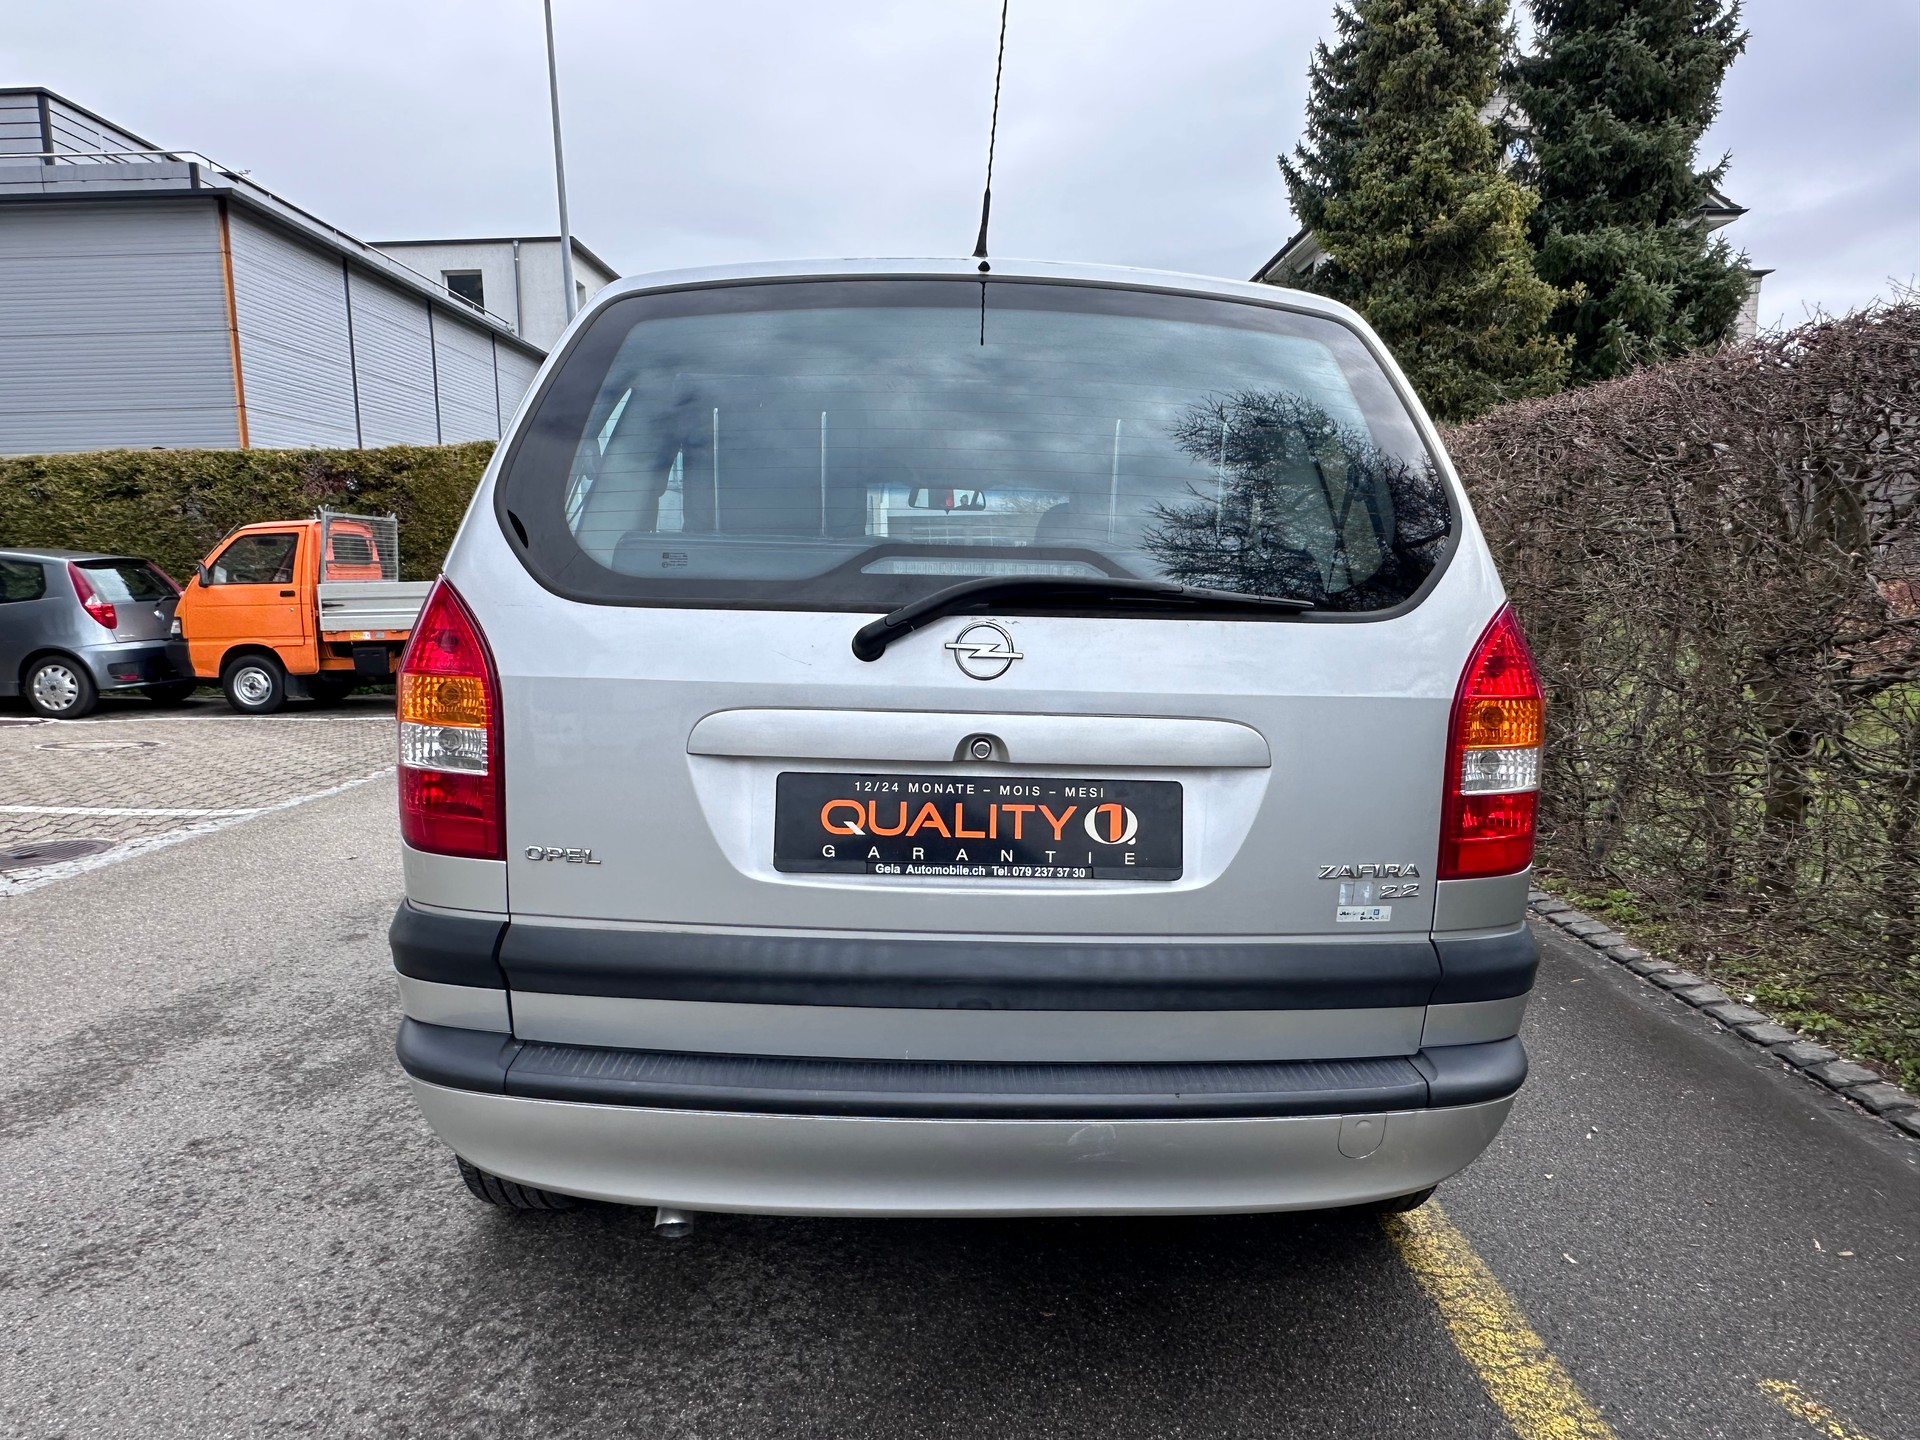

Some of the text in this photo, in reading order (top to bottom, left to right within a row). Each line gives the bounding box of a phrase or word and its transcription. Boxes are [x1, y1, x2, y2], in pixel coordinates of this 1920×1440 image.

[855, 781, 899, 792] 12/24
[908, 782, 975, 794] MONATE
[999, 785, 1041, 796] MOIS
[1065, 787, 1104, 798] MESI
[821, 799, 1078, 841] QUALITY
[525, 845, 601, 864] OPEL
[822, 844, 1136, 865] GARANTIE
[875, 863, 1086, 879] Gela Automobile.ch Tel. 079 237 37 30
[1318, 863, 1420, 879] ZAFIRA
